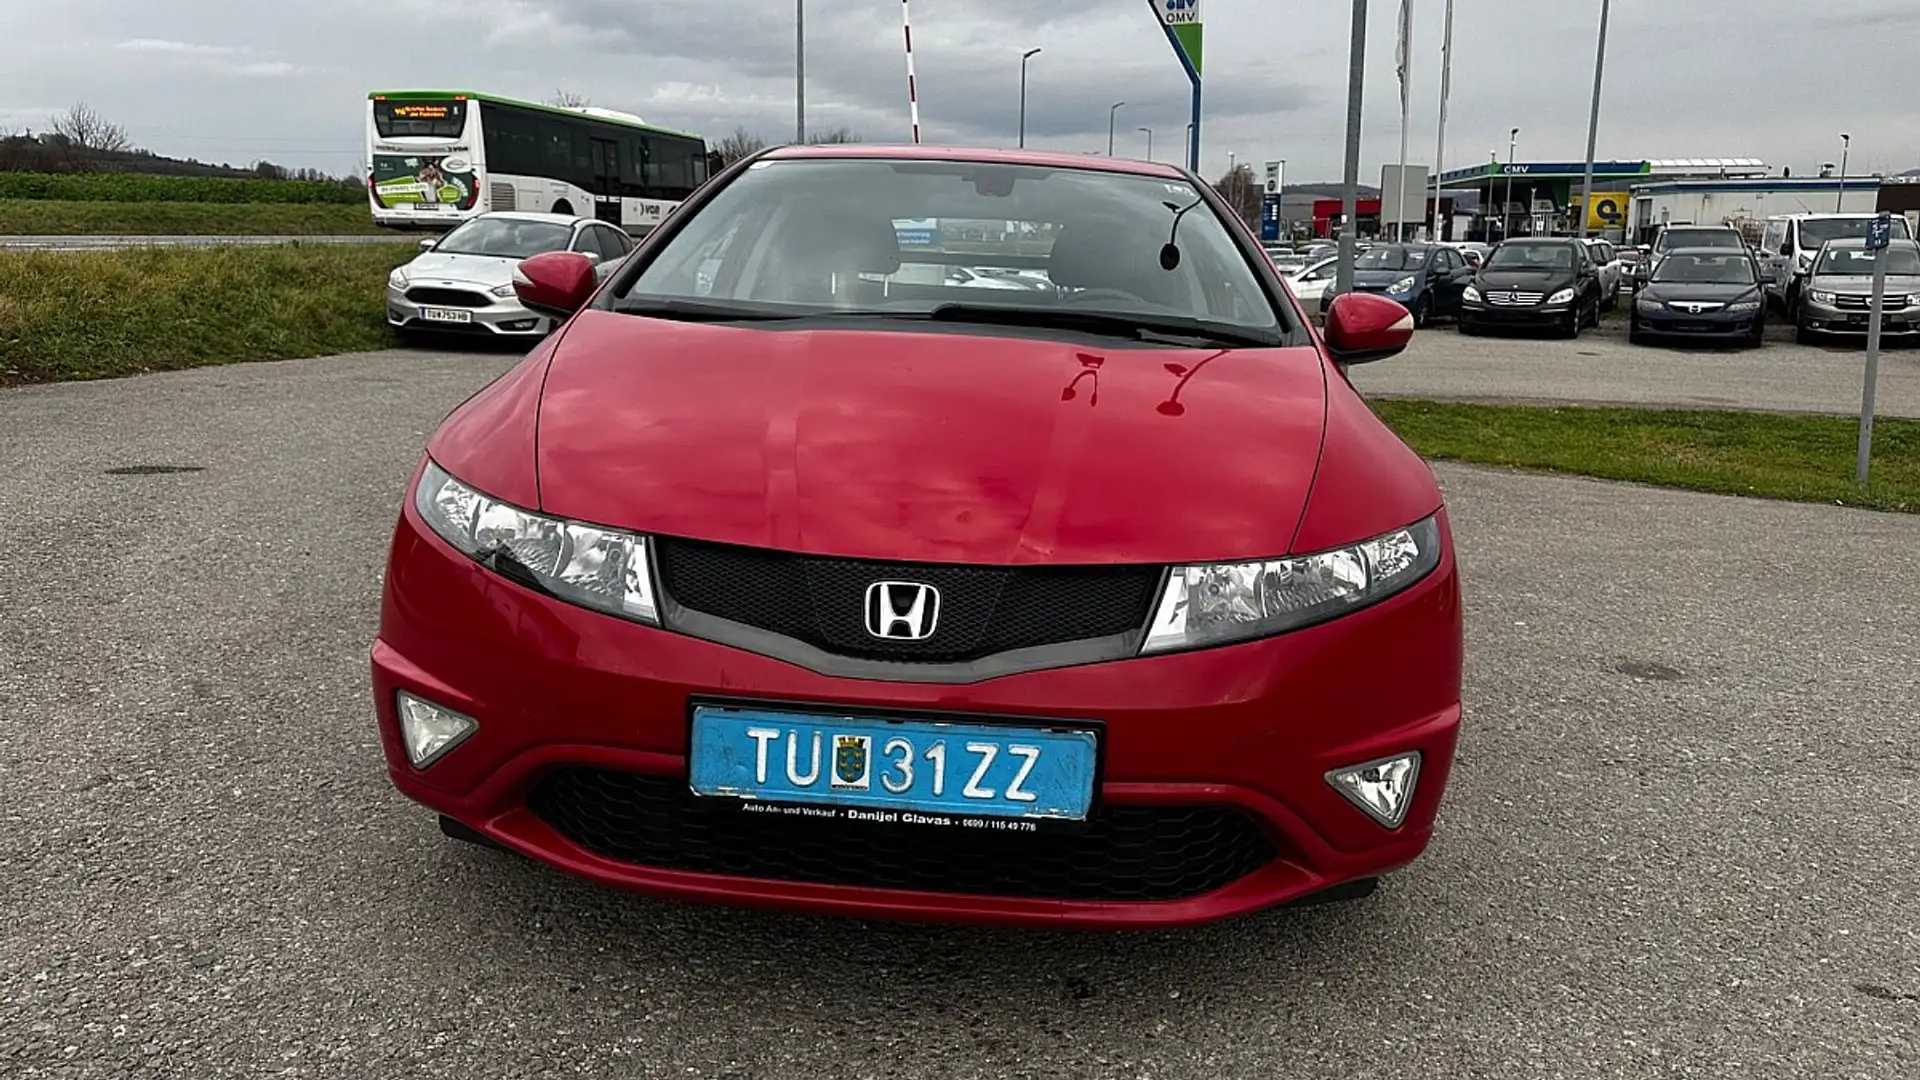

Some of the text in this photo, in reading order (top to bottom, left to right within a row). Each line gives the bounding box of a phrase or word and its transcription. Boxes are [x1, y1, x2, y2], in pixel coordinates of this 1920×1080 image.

[1166, 13, 1195, 23] OMV
[1503, 165, 1529, 174] OMV
[747, 728, 1042, 802] TU 31 ZZ
[742, 803, 765, 812] Auto
[783, 807, 801, 815] und
[802, 807, 836, 817] Verkauf
[847, 809, 897, 822] Danijel
[902, 812, 951, 825] Glavas
